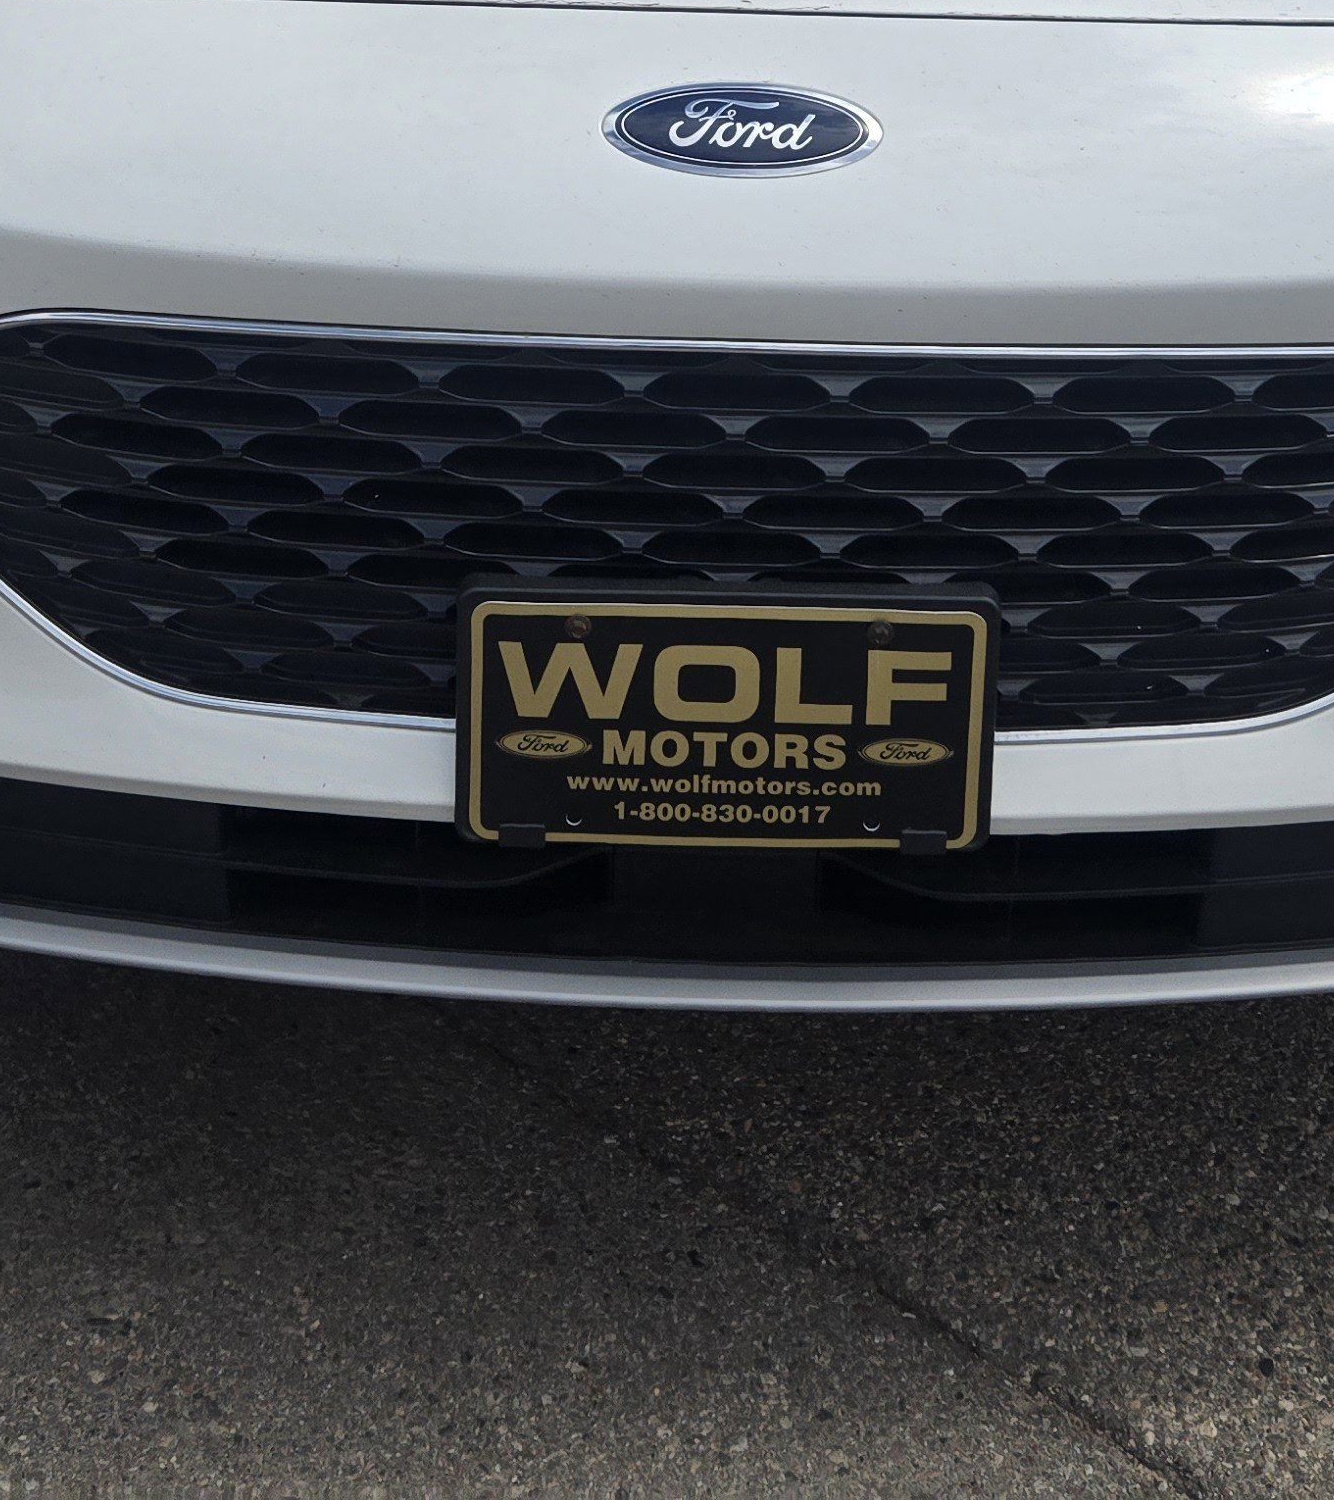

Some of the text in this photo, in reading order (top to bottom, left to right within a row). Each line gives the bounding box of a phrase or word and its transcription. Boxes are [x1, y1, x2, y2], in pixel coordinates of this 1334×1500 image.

[669, 99, 816, 150] Ford
[498, 641, 952, 726] WOLF
[517, 733, 570, 753] Ford
[602, 729, 847, 770] MOTORS
[879, 742, 932, 761] Ford
[567, 774, 882, 797] www.wolfmotors.com
[614, 801, 832, 825] 1-800-830-0017
